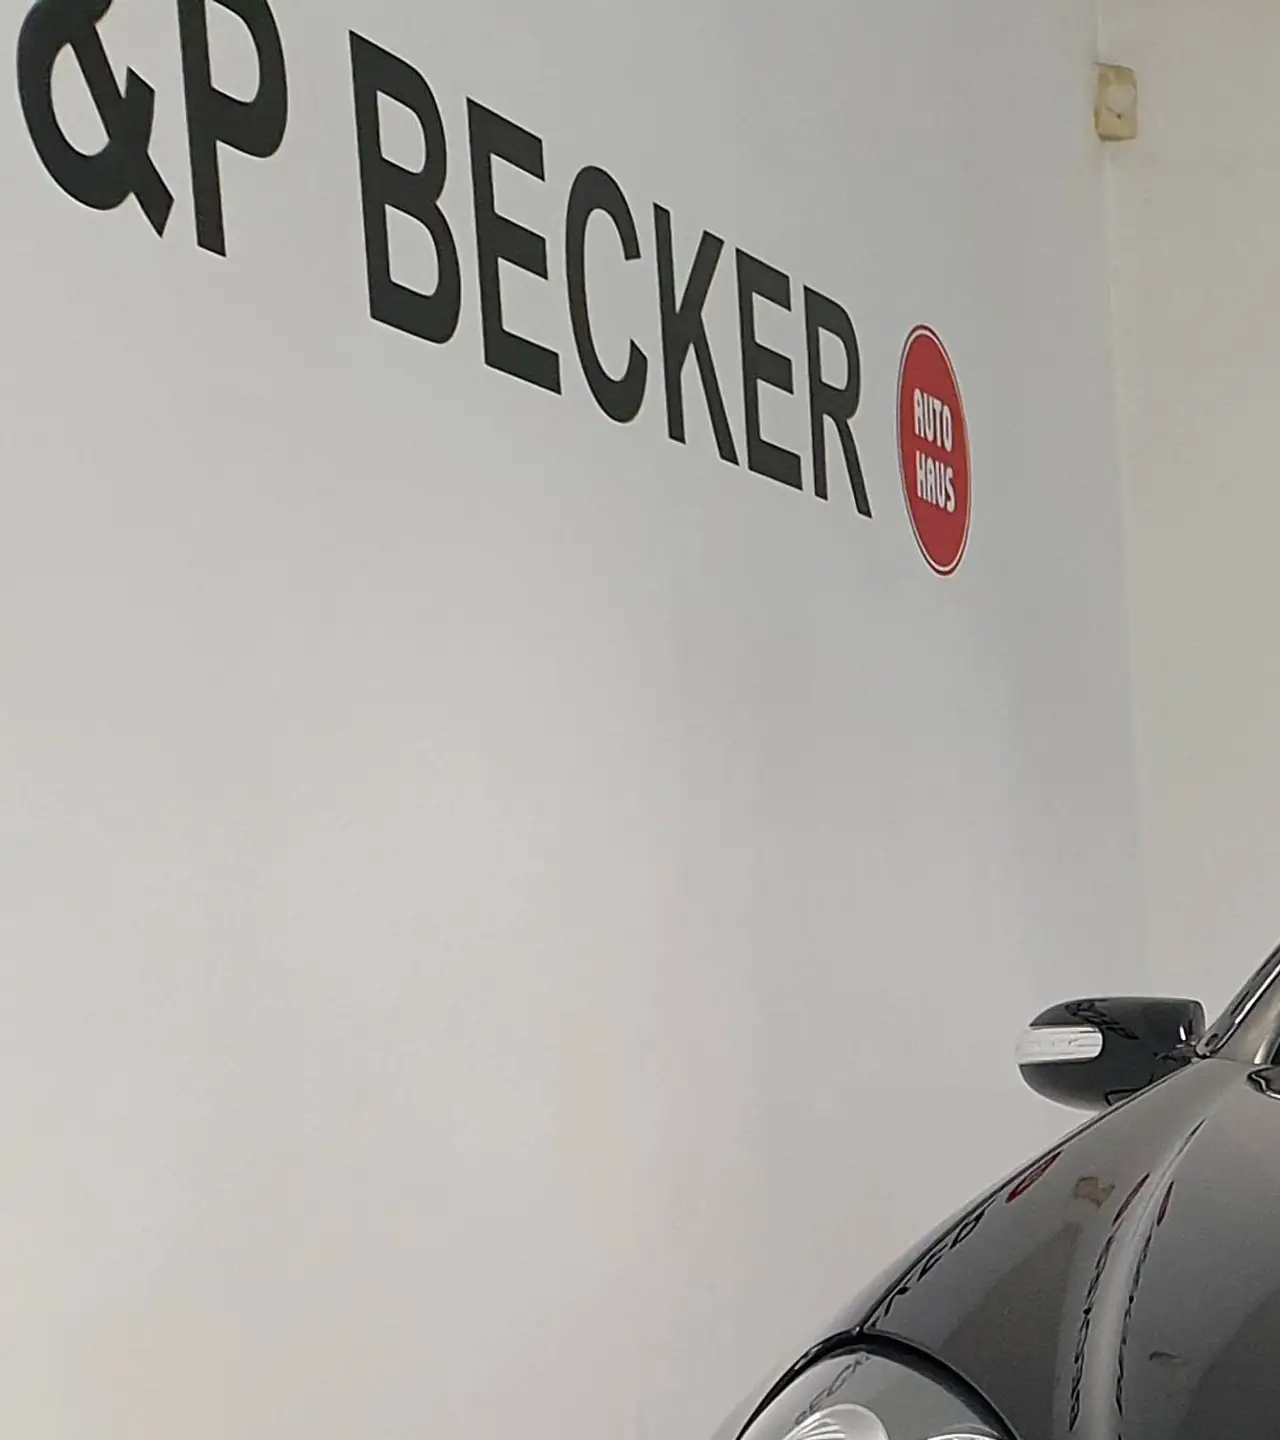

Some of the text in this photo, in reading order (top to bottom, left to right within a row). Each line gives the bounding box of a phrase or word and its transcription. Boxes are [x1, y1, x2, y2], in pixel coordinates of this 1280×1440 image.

[348, 29, 873, 520] BECKER
[912, 387, 953, 453] AUTO
[914, 450, 956, 514] HAUS
